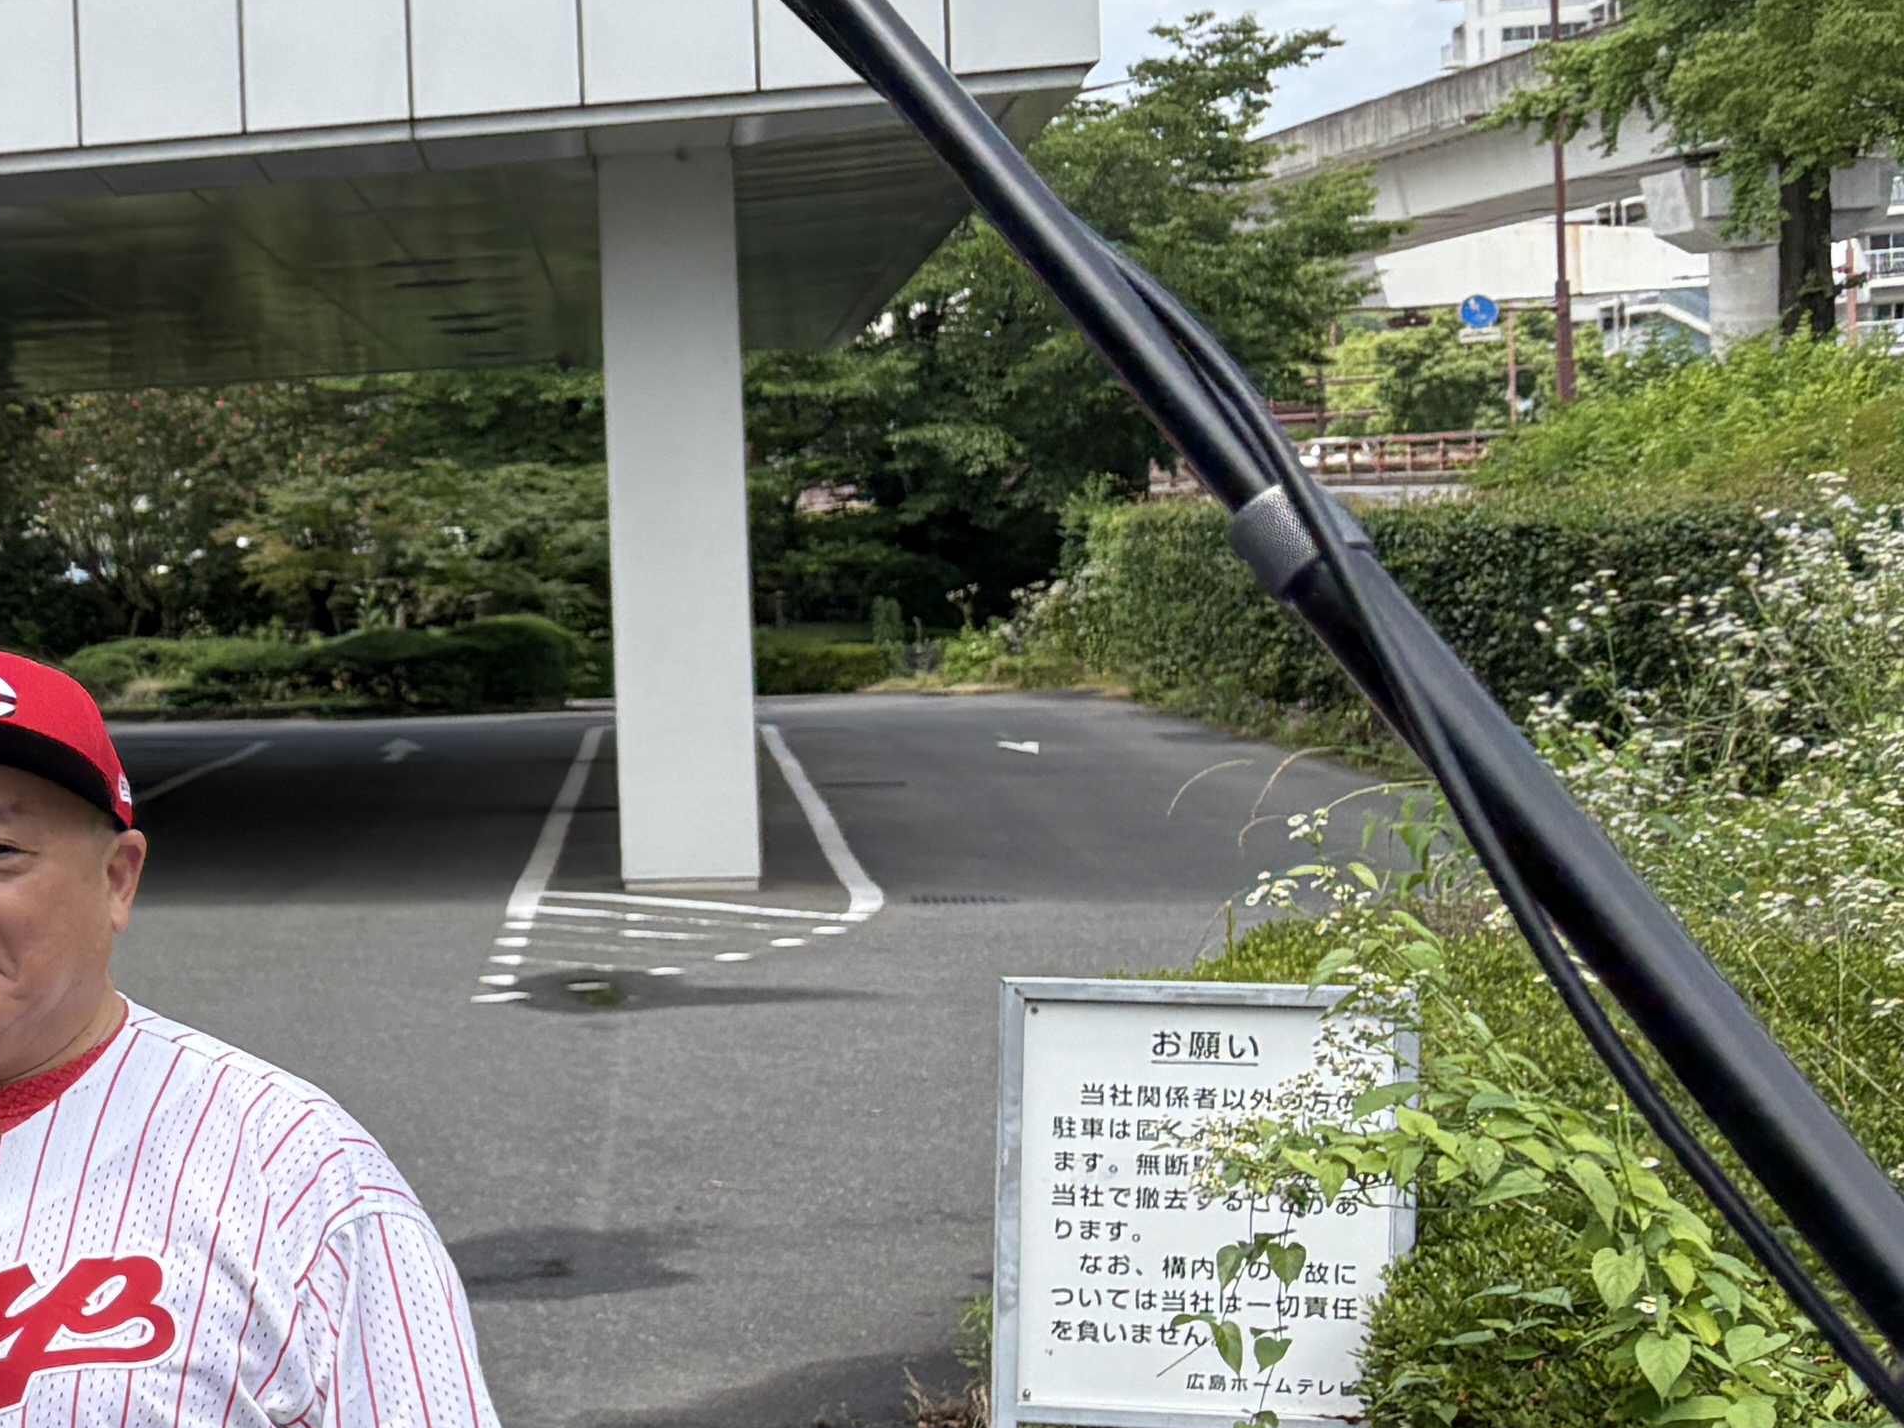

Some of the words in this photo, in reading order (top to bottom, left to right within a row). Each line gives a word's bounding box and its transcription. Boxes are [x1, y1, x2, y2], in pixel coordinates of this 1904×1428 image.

[1151, 1030, 1260, 1060] お願い
[1055, 1218, 1142, 1244] ります。
